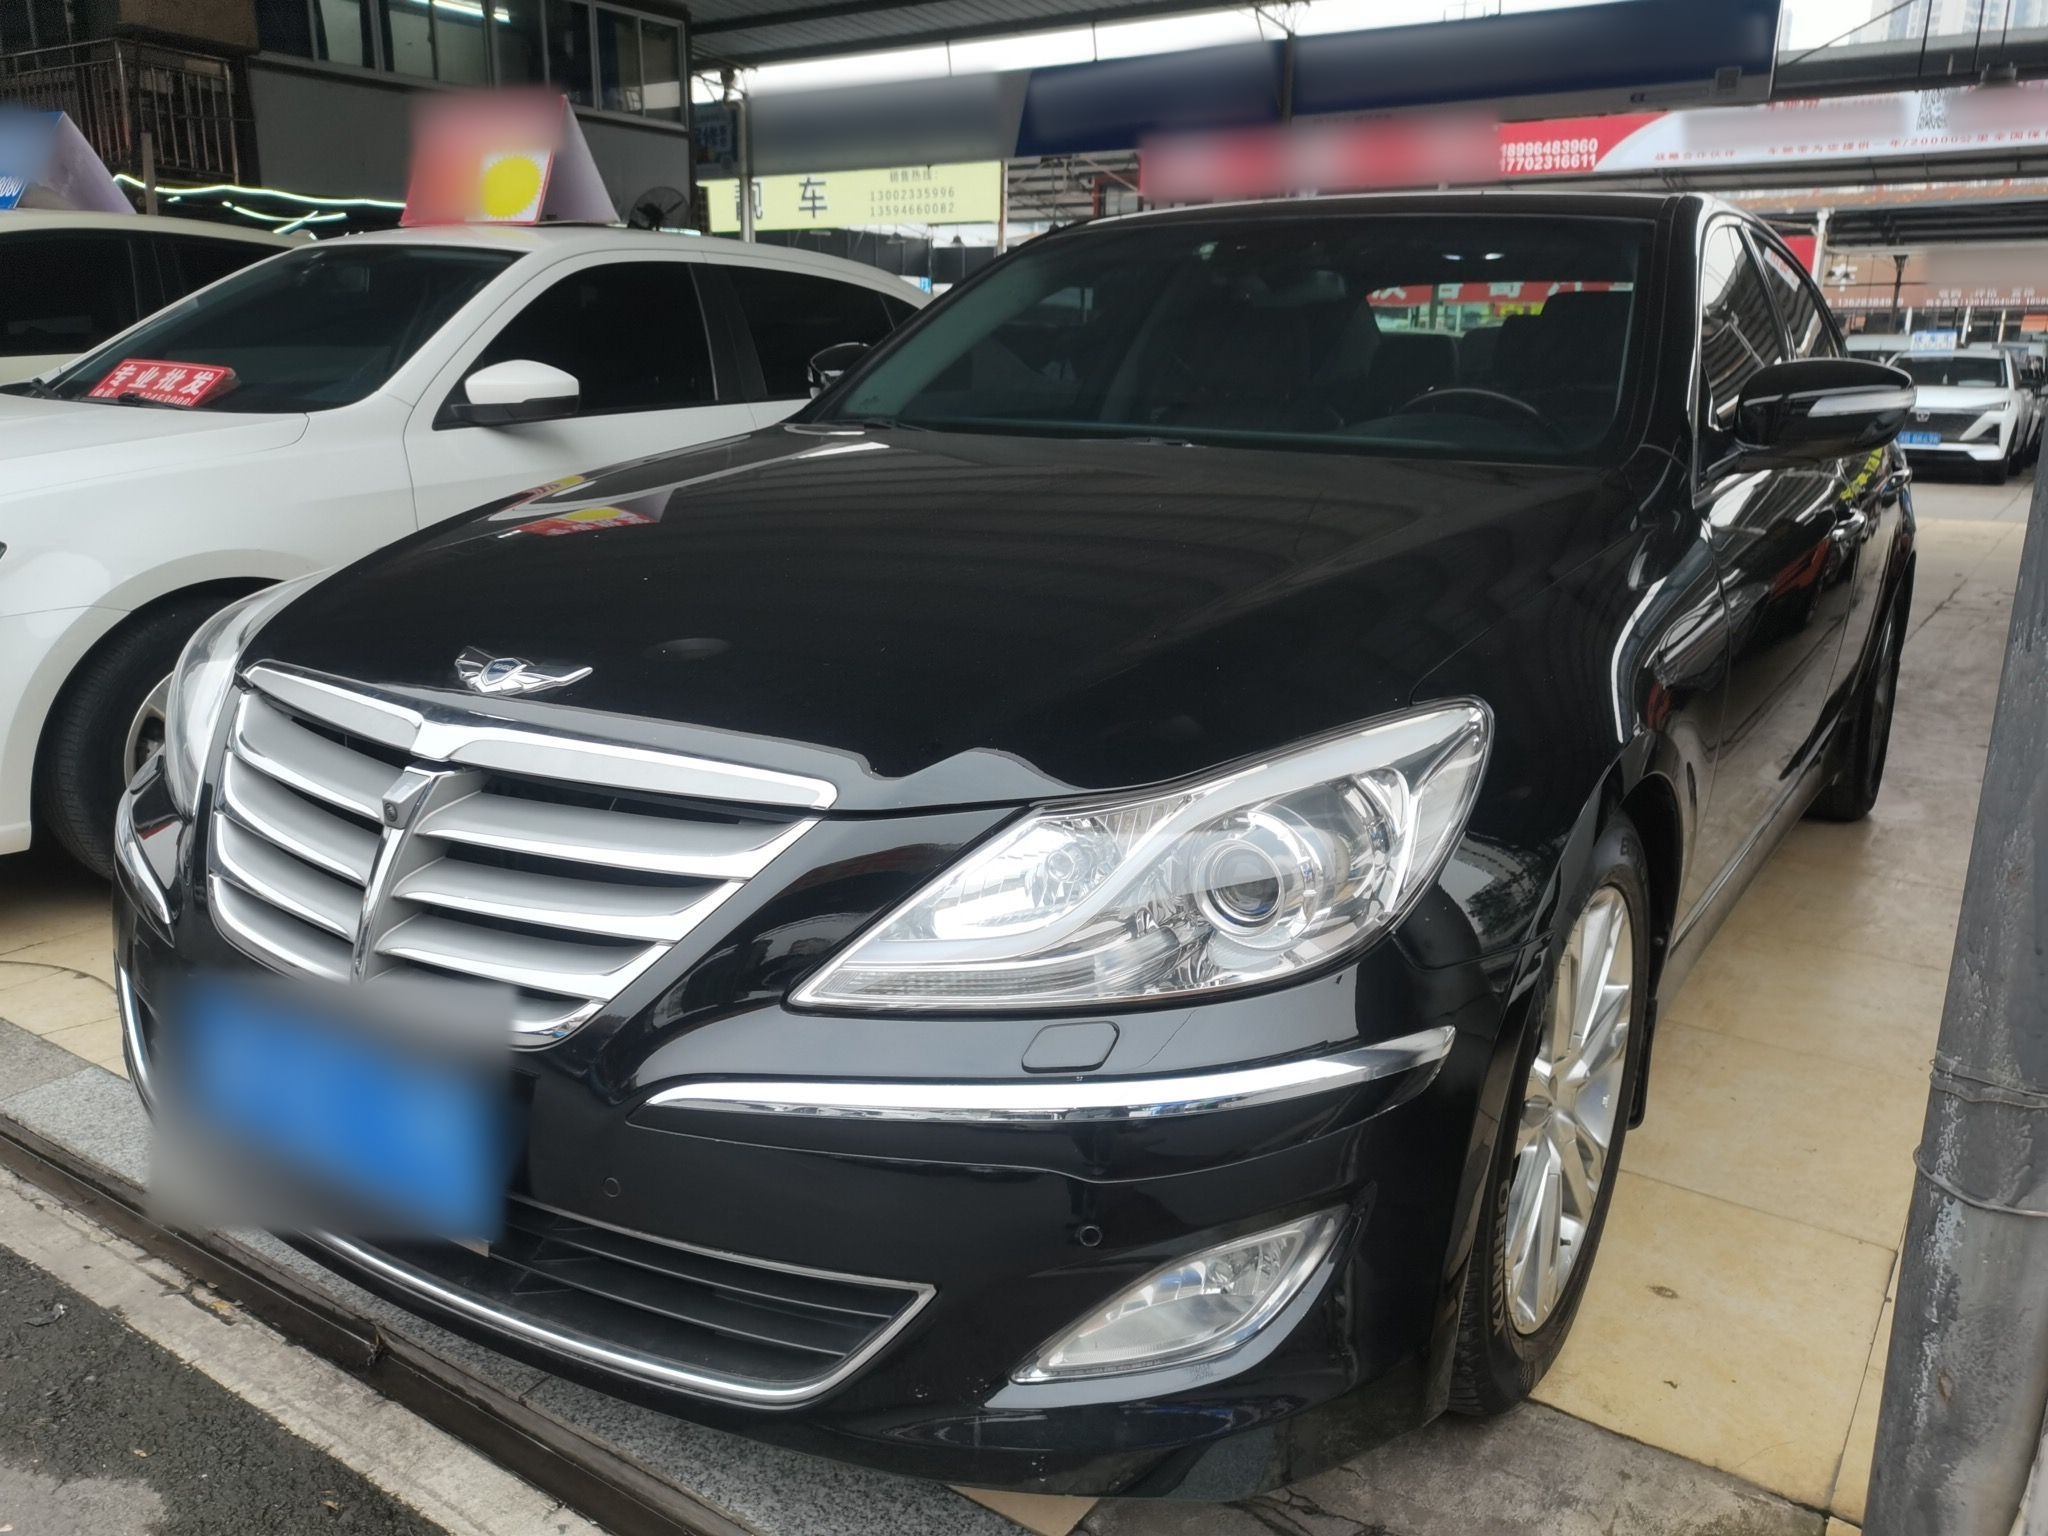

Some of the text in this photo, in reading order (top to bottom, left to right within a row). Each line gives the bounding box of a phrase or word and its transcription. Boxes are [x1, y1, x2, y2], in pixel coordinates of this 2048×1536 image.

[110, 364, 215, 395] 专业批发
[1493, 1179, 1510, 1337] KUMHO
